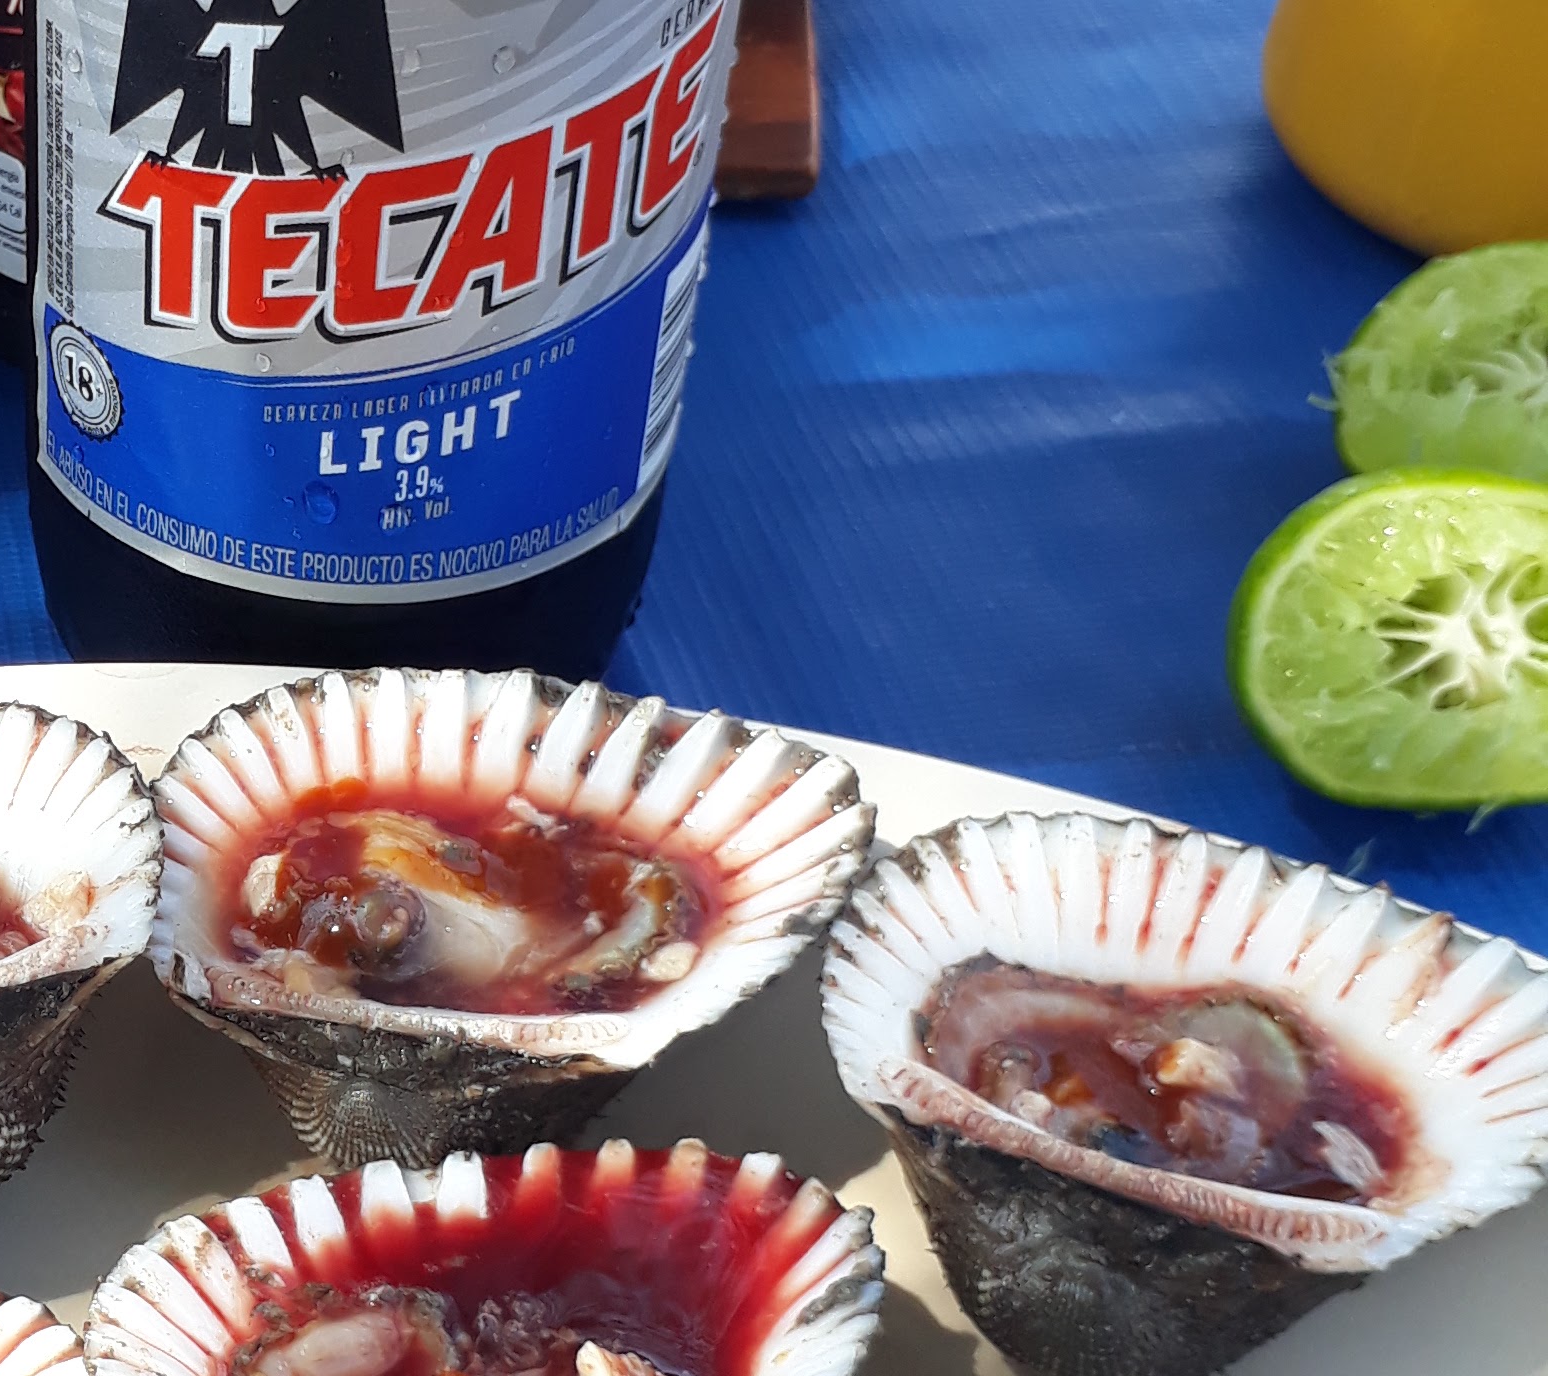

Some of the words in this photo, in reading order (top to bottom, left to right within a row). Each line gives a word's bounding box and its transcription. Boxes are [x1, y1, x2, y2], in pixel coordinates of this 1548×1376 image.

[97, 1, 727, 346] TECATE
[263, 404, 343, 423] CERVEZA
[351, 394, 409, 420] LAGER
[511, 357, 532, 381] EN
[319, 389, 521, 476] LIGHT
[47, 430, 58, 464] EL
[58, 445, 93, 498] ABUSO
[95, 481, 113, 513] EN
[115, 491, 134, 524] EL
[136, 502, 218, 557] CONSUMO
[222, 535, 246, 567] DE
[251, 544, 296, 578] ESTE
[302, 552, 404, 584] PRODUCTO
[410, 553, 433, 582] ES
[439, 540, 504, 577] NOCIVO
[509, 525, 550, 564] PARA
[554, 514, 573, 544] LA
[575, 486, 620, 537] SALUD
[394, 465, 444, 502] 3.9%
